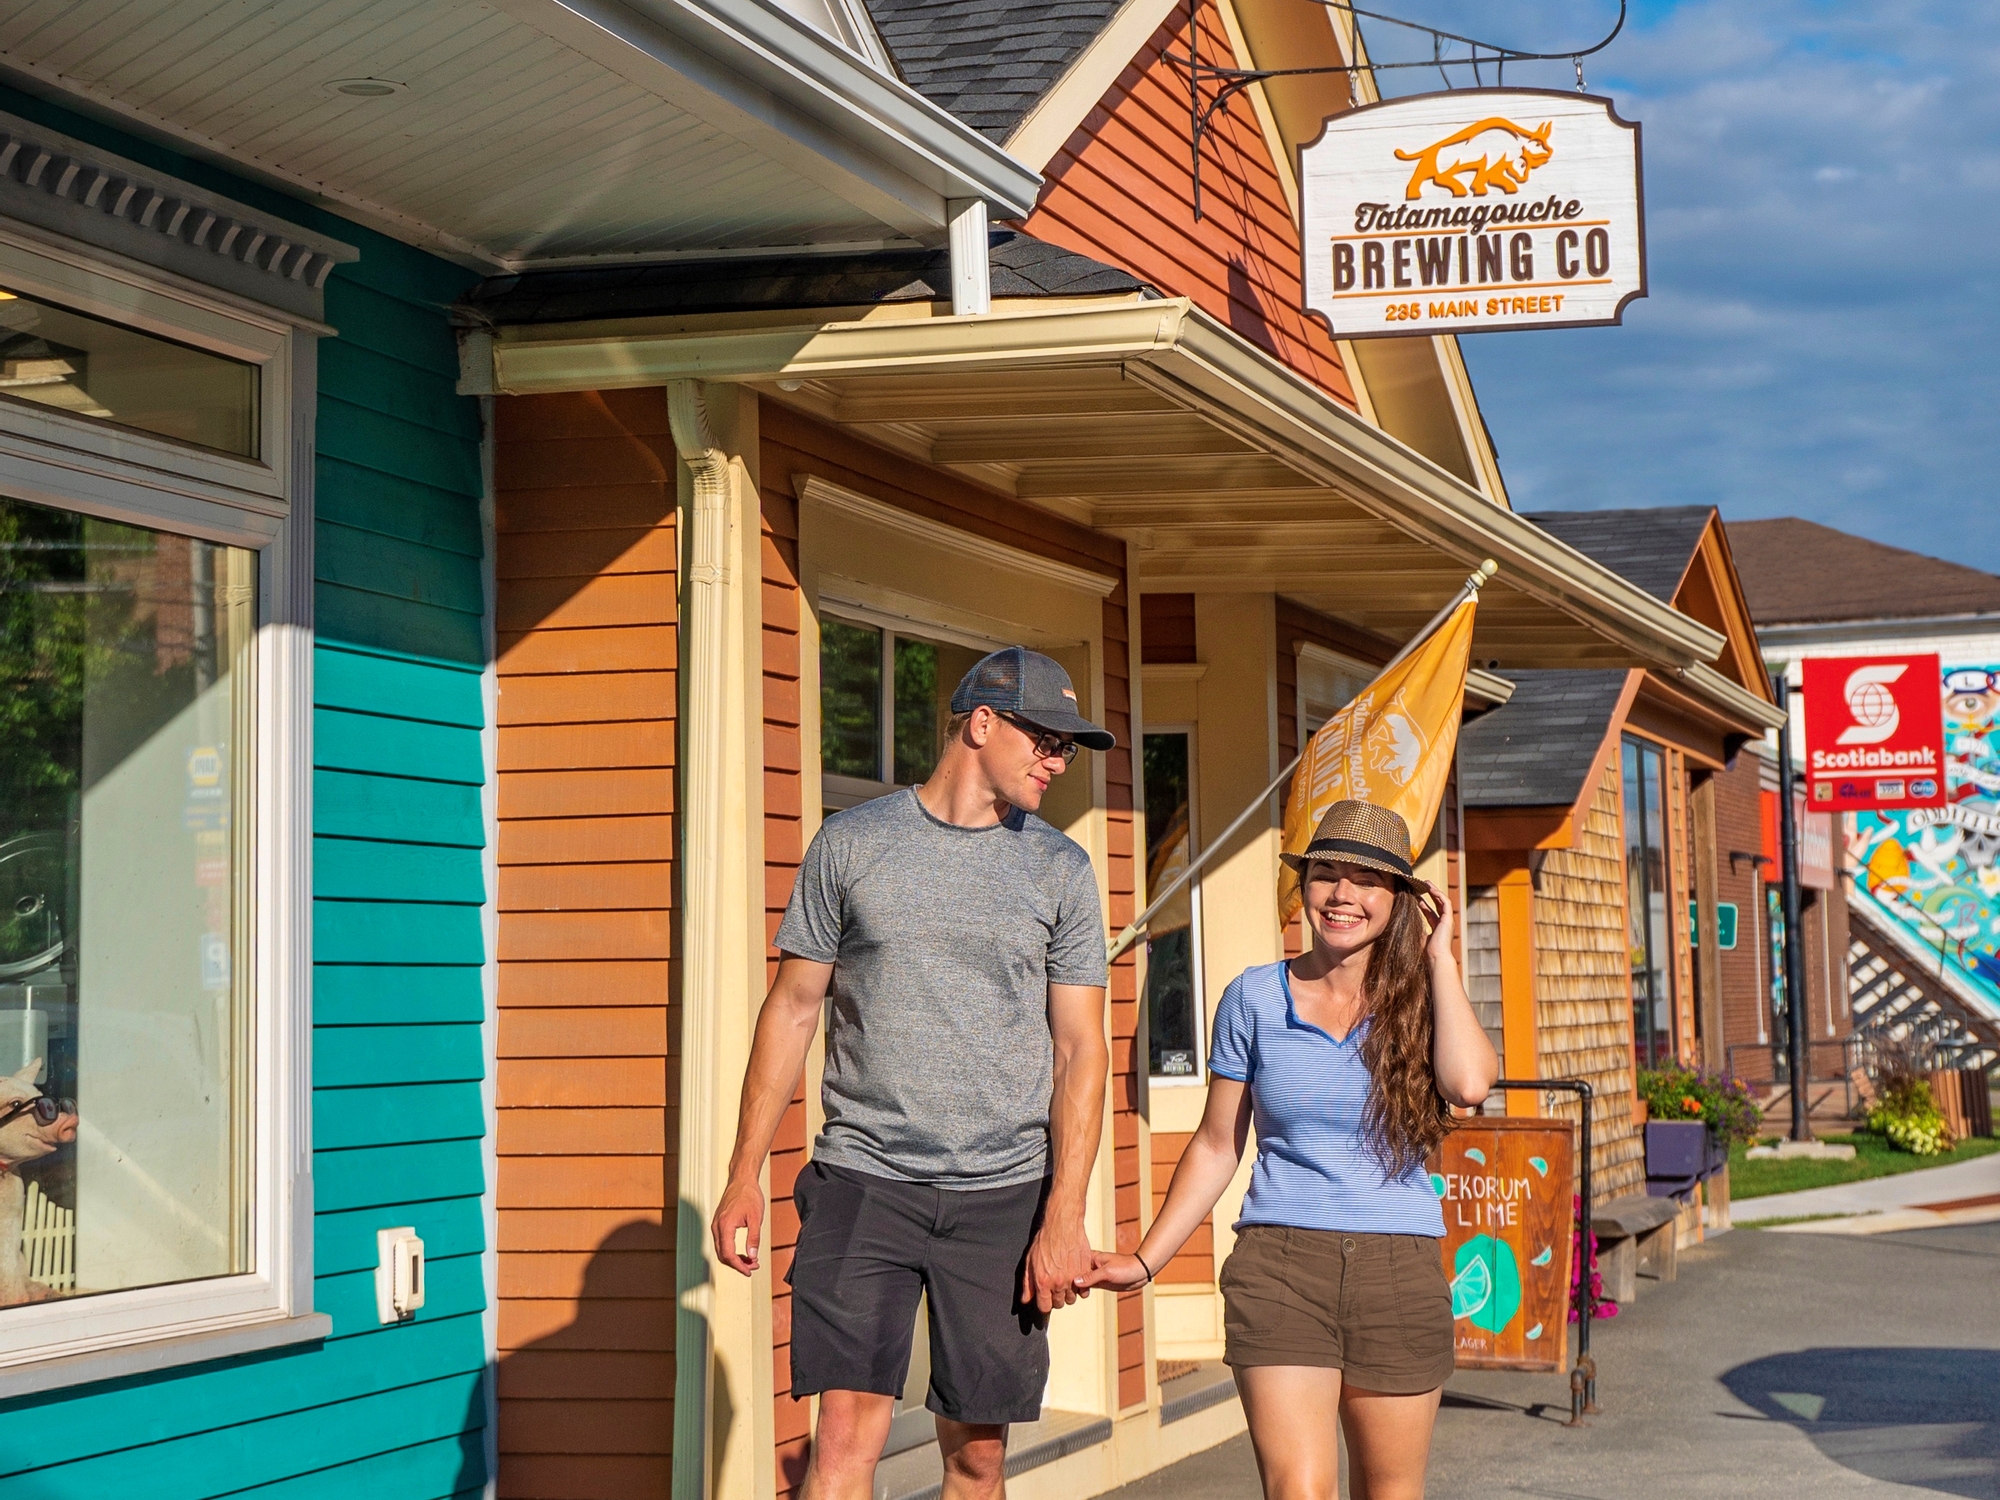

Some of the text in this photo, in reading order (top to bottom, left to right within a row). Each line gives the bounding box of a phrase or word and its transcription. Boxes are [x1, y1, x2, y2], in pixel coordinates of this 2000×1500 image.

[1354, 195, 1584, 234] Tatamagouche
[1332, 228, 1610, 291] BREWING CO
[1385, 294, 1564, 321] 235 MAIN STREET
[1344, 691, 1374, 803] Tatamagouch
[1812, 745, 1937, 769] Scotiabank
[1457, 1201, 1518, 1228] LIME
